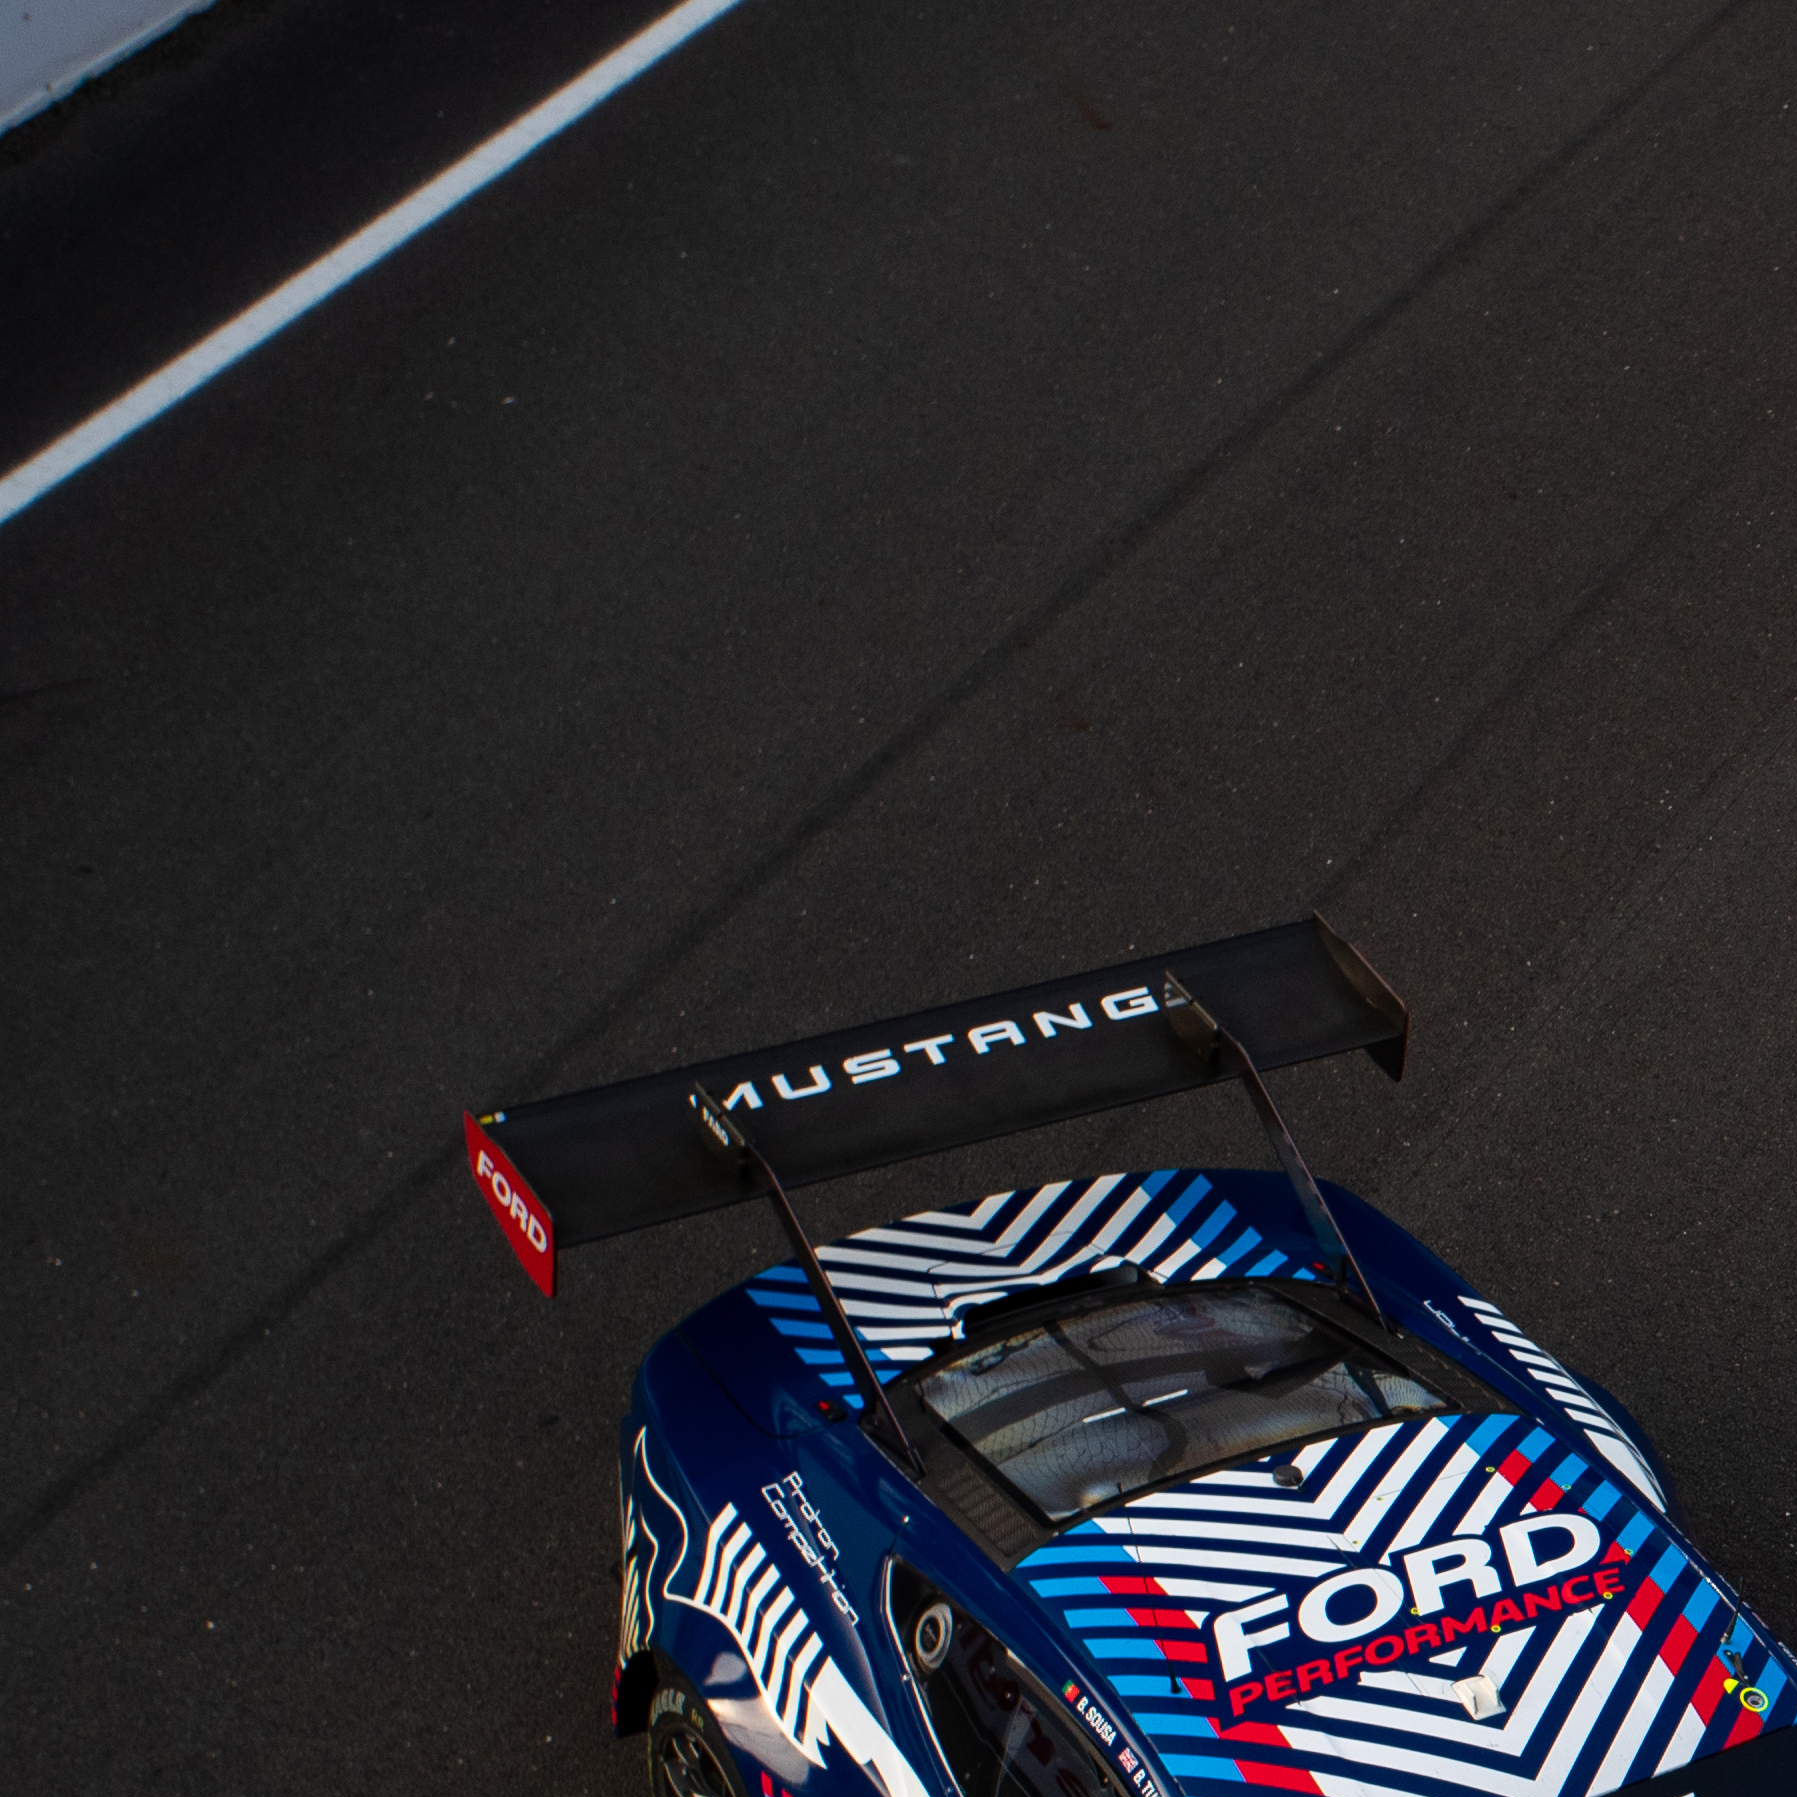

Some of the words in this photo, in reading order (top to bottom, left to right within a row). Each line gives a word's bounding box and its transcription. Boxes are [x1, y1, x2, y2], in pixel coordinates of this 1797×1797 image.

[476, 1150, 548, 1253] FORD
[783, 1471, 839, 1561] Proton
[1212, 1513, 1601, 1683] FORD
[1229, 1566, 1625, 1718] PERFORMANCE
[1076, 1696, 1087, 1715] B.
[1085, 1706, 1117, 1747] SOUSA
[1133, 1769, 1145, 1789] B.
